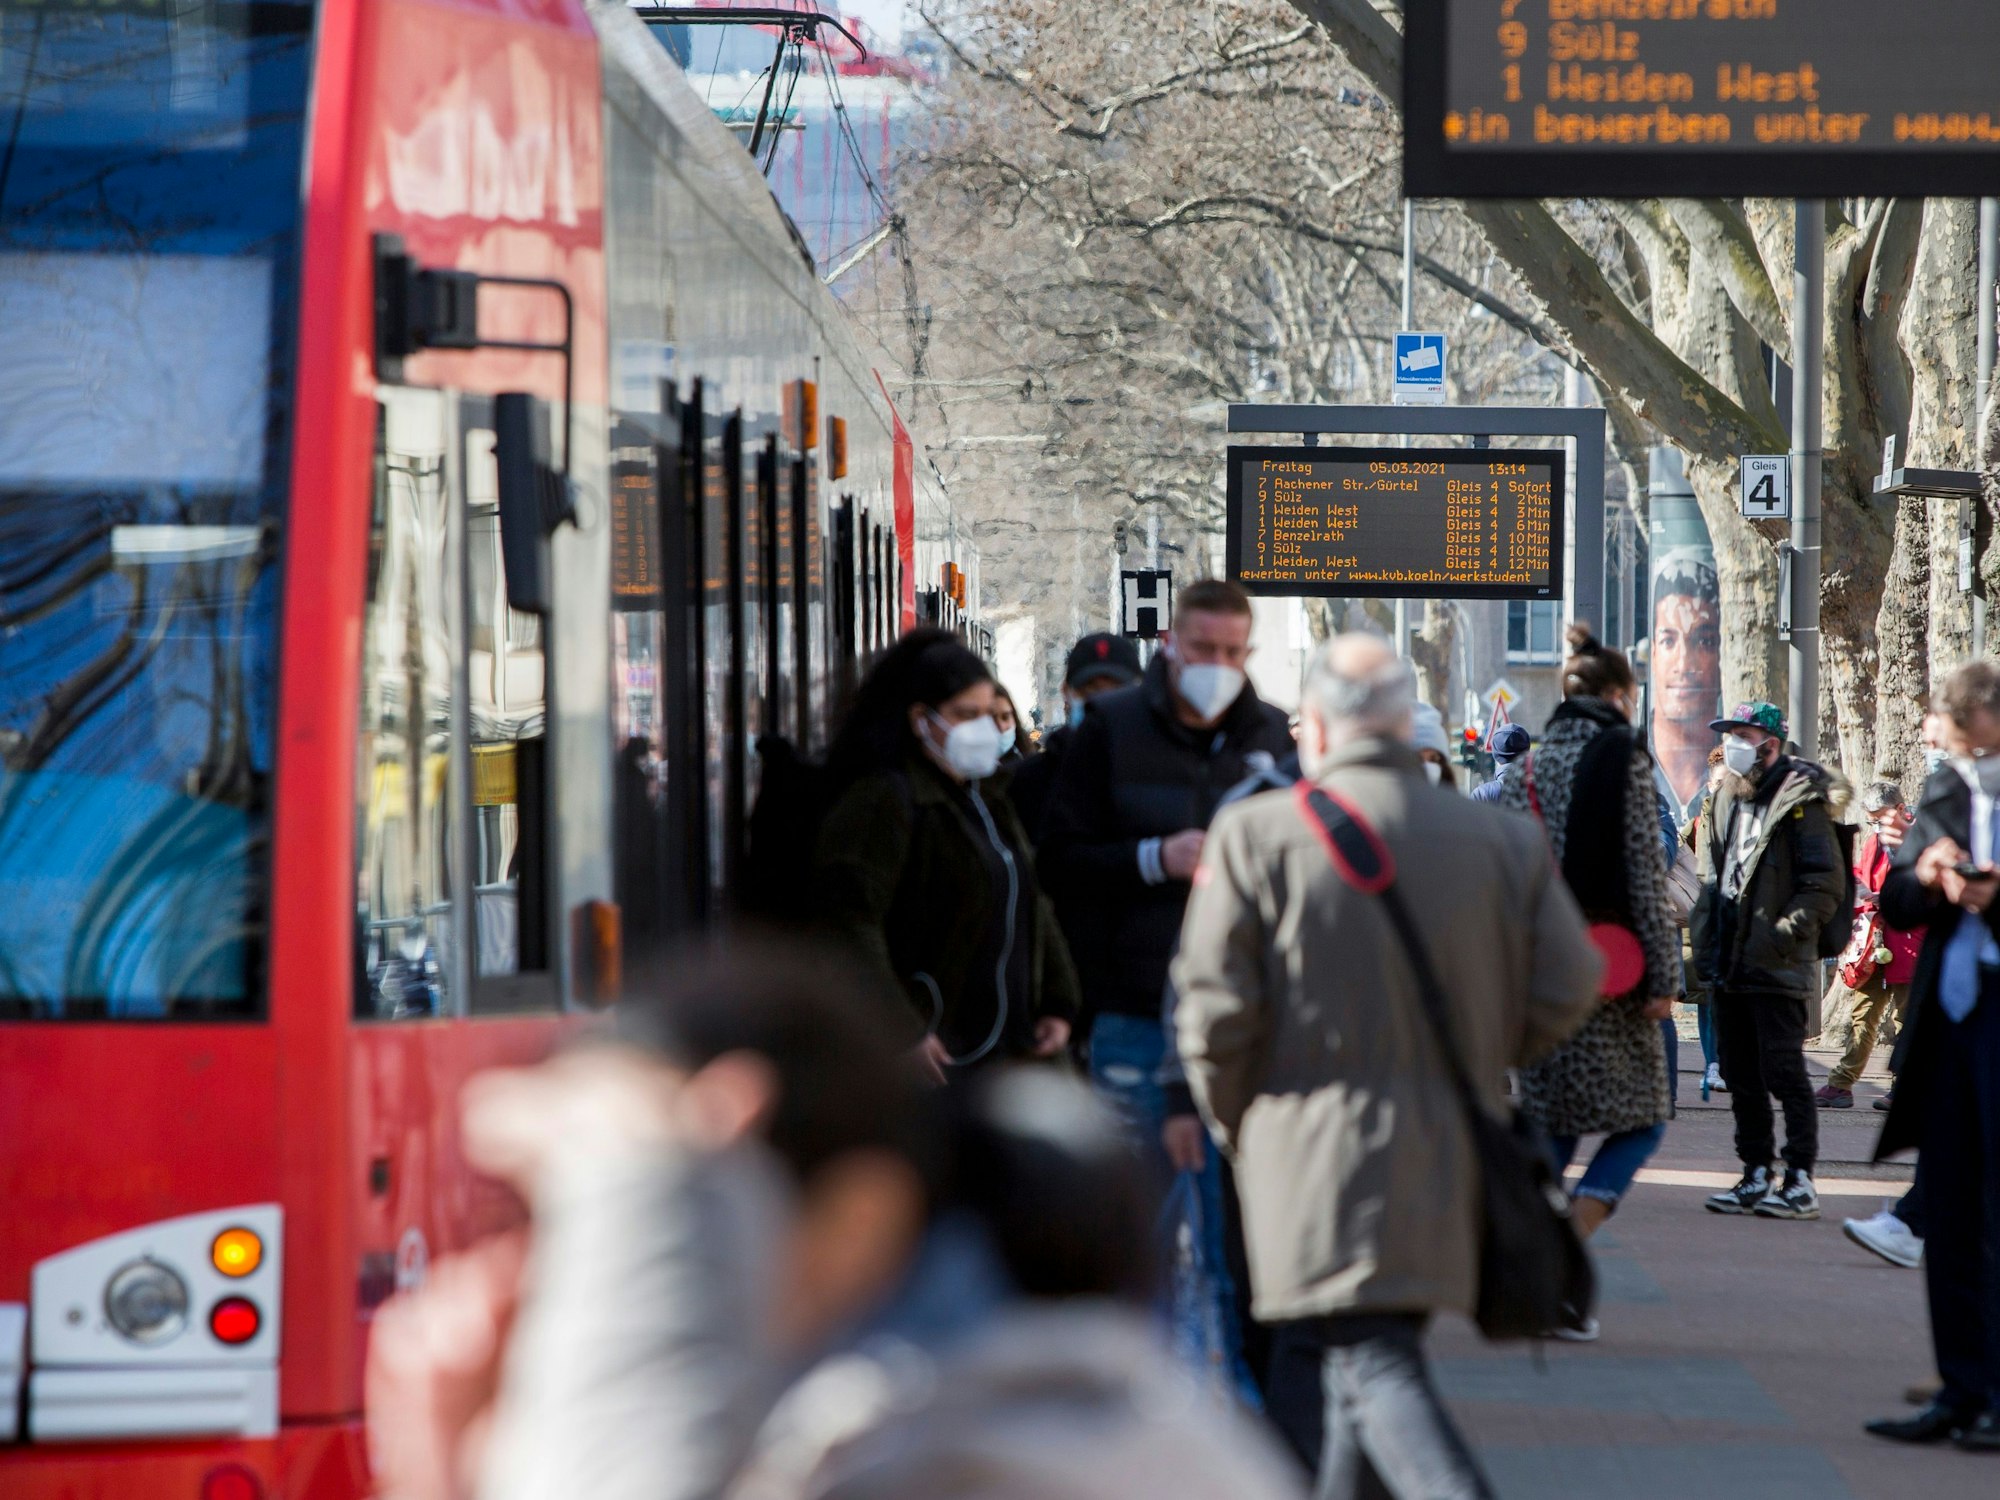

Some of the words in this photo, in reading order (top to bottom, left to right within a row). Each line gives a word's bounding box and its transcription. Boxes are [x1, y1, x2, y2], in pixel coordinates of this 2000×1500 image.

[1498, 21, 1527, 58] 9
[1502, 62, 1522, 102] 1
[1548, 62, 1694, 102] Weiden
[1716, 62, 1819, 102] West
[1534, 103, 1731, 143] bewerben
[1754, 103, 1870, 143] unter
[1263, 460, 1312, 475] Freitag
[1370, 462, 1445, 474] 05.03.2021
[1489, 464, 1526, 475] 13:14
[1752, 461, 1777, 470] Gleis
[1258, 478, 1267, 489] 7
[1275, 478, 1333, 490] Aachener
[1343, 479, 1418, 491] Str./Gürtel
[1447, 480, 1481, 491] Gleis
[1491, 481, 1499, 491] 4
[1509, 481, 1551, 495] Sofort
[1749, 475, 1780, 510] 4
[1258, 491, 1266, 502] 9
[1274, 491, 1302, 502] Sülz
[1447, 493, 1481, 504] Gleis
[1490, 494, 1498, 504] 4
[1259, 504, 1265, 515] 1
[1274, 504, 1318, 515] Weiden
[1328, 504, 1358, 516] West
[1447, 506, 1480, 517] Gleis
[1490, 507, 1498, 517] 4
[1259, 517, 1265, 527] 1
[1274, 517, 1318, 528] Weiden
[1327, 517, 1358, 528] West
[1447, 519, 1480, 530] Gleis
[1490, 520, 1498, 530] 4
[1258, 529, 1266, 540] 7
[1274, 529, 1344, 541] Benzelrath
[1446, 532, 1480, 543] Gleis
[1490, 532, 1498, 543] 4
[1258, 542, 1266, 553] 9
[1274, 543, 1301, 553] Sülz
[1446, 545, 1480, 556] Gleis
[1490, 546, 1498, 556] 4
[1259, 555, 1264, 566] 1
[1273, 555, 1317, 566] Weiden
[1326, 556, 1358, 567] West
[1446, 558, 1479, 568] Gleis
[1490, 558, 1497, 568] 4
[1305, 569, 1340, 580] unter
[1349, 570, 1530, 583] www.kvb.koeln/werkstudent
[1124, 578, 1169, 632] H
